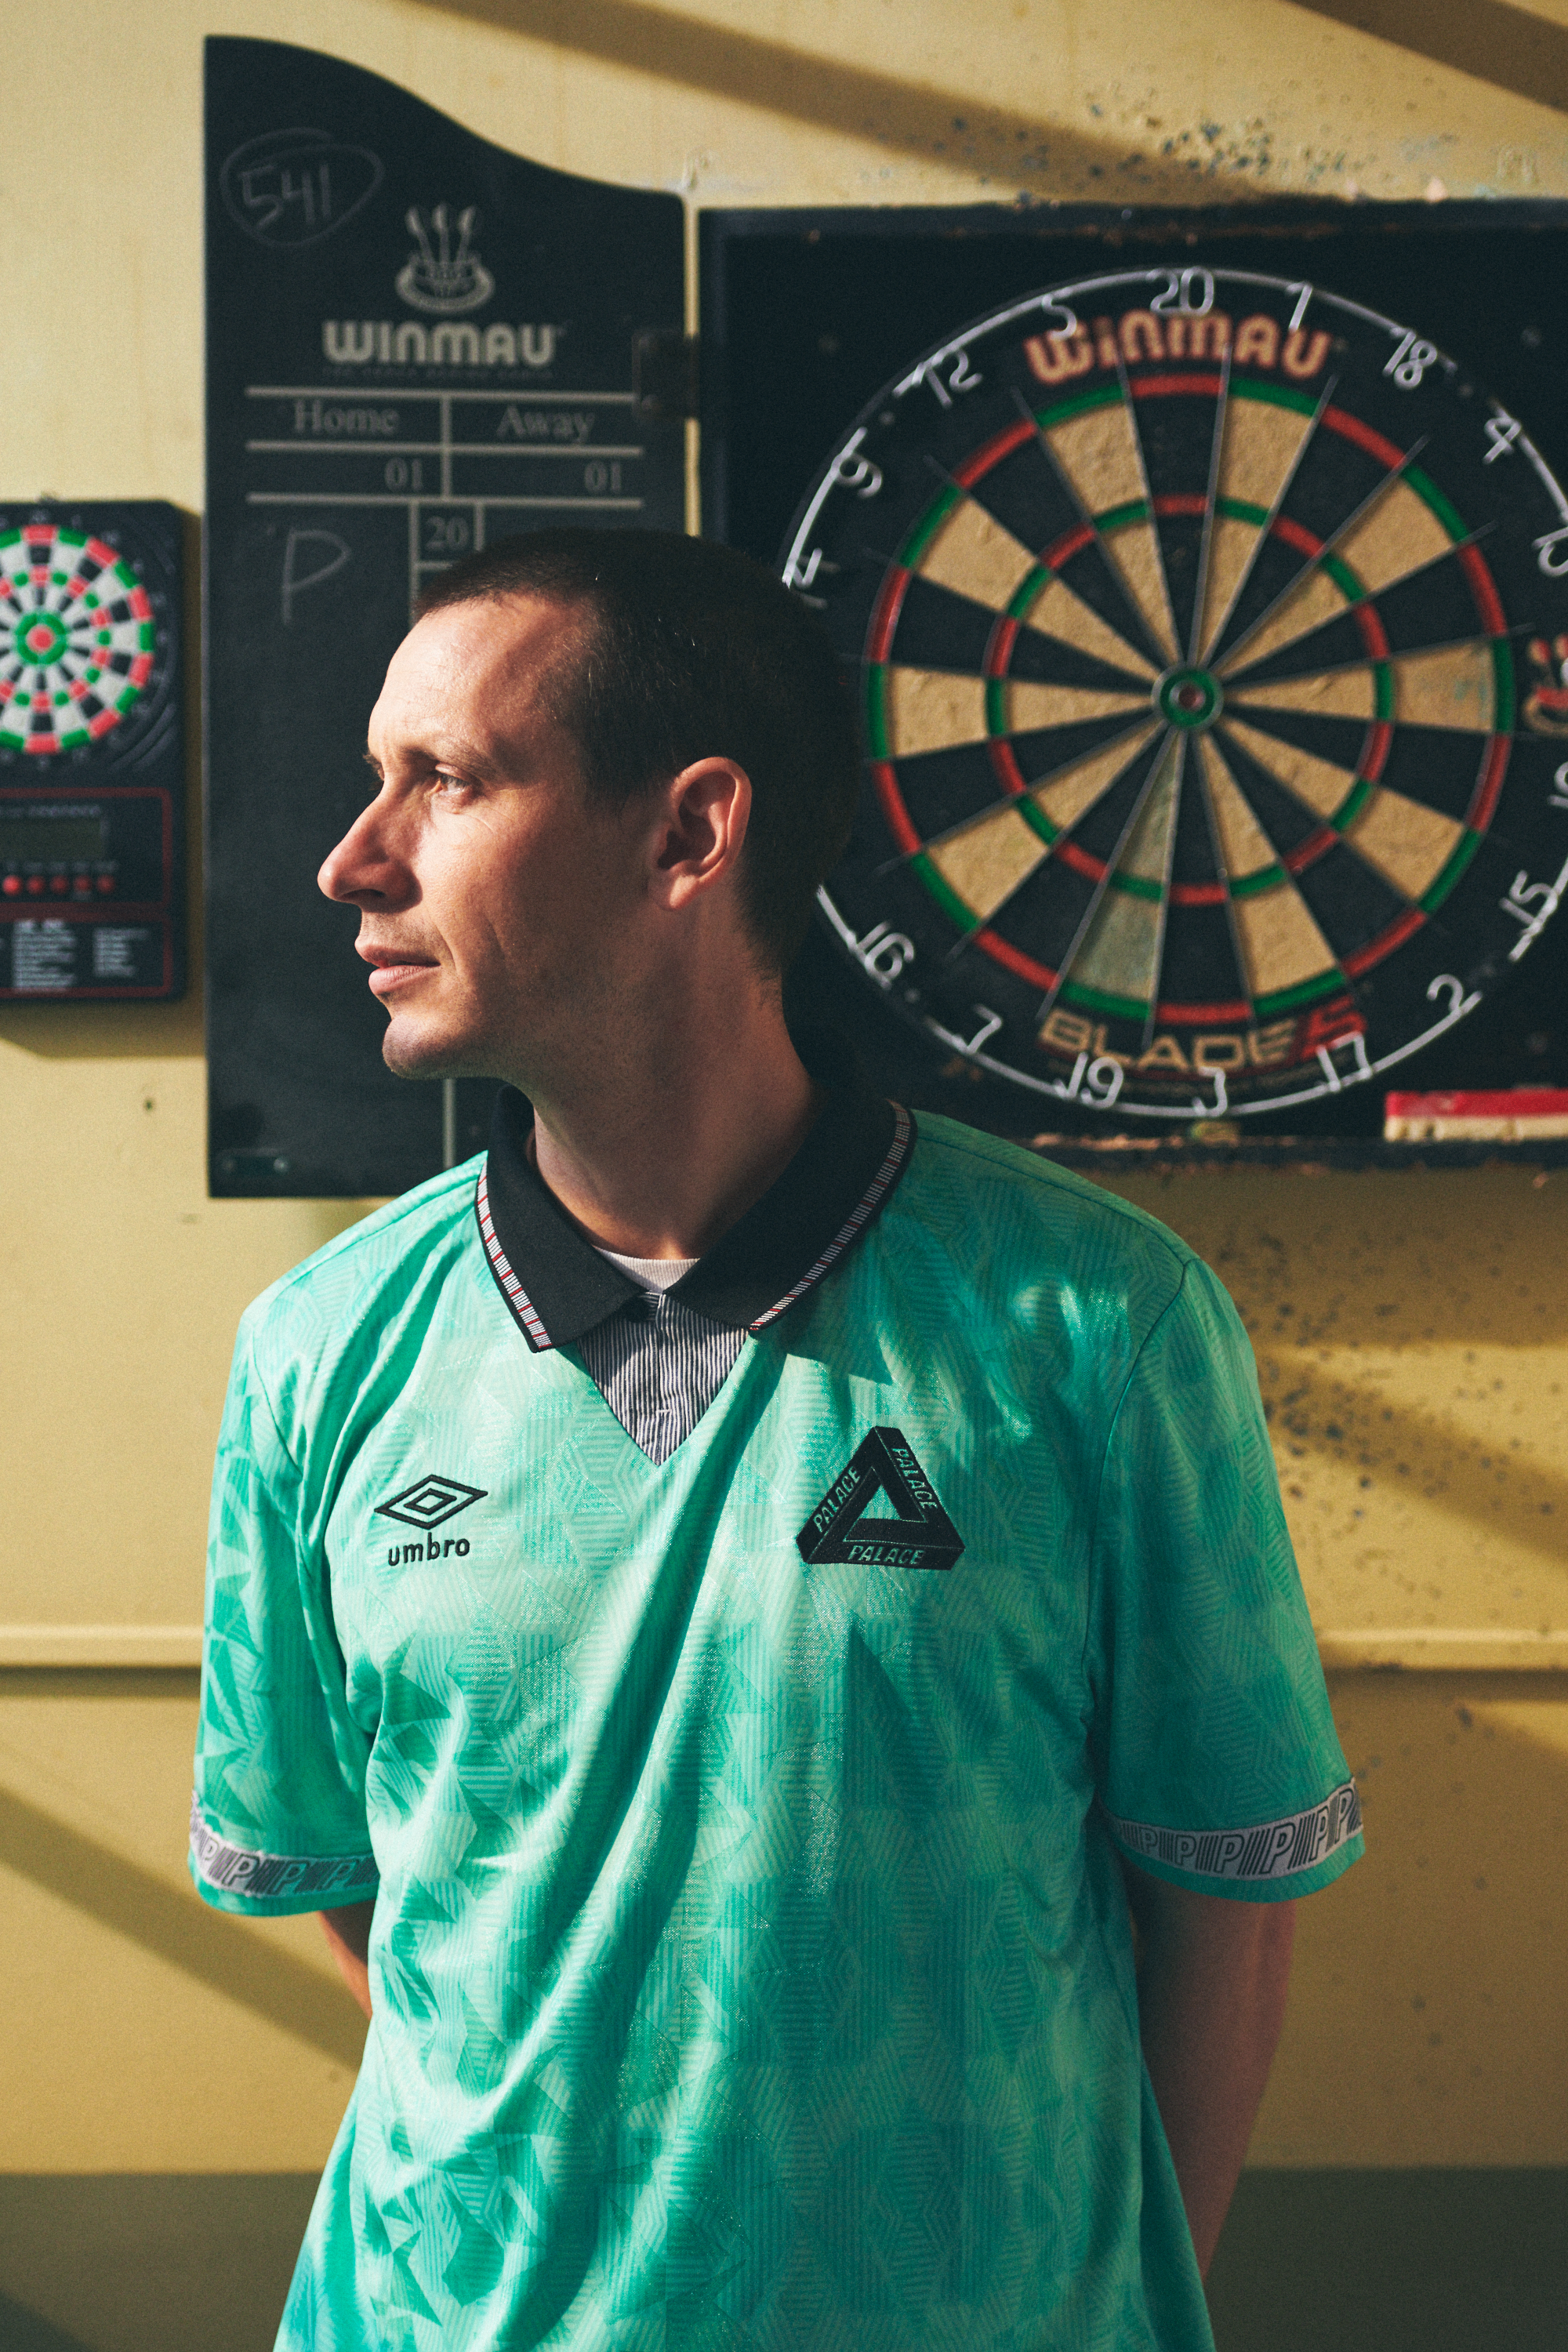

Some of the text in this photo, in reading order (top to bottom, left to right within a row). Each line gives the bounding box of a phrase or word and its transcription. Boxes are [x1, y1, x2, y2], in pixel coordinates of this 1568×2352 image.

[1149, 267, 1214, 317] 20
[321, 319, 557, 366] WINMAU
[1024, 309, 1332, 382] WINMAU
[1382, 328, 1439, 390] 18
[912, 349, 983, 408] 12
[292, 400, 400, 436] Home
[496, 406, 597, 446] Away
[1483, 416, 1523, 465] 4
[384, 458, 423, 493] 01
[584, 462, 622, 495] 01
[834, 451, 883, 499] 9
[425, 517, 468, 551] 20
[1500, 869, 1559, 937] 15
[850, 919, 915, 988] 16
[812, 1465, 861, 1533] PALACE
[891, 1448, 938, 1510] PALACE
[388, 1532, 470, 1566] umbro
[847, 1544, 925, 1565] PALACE
